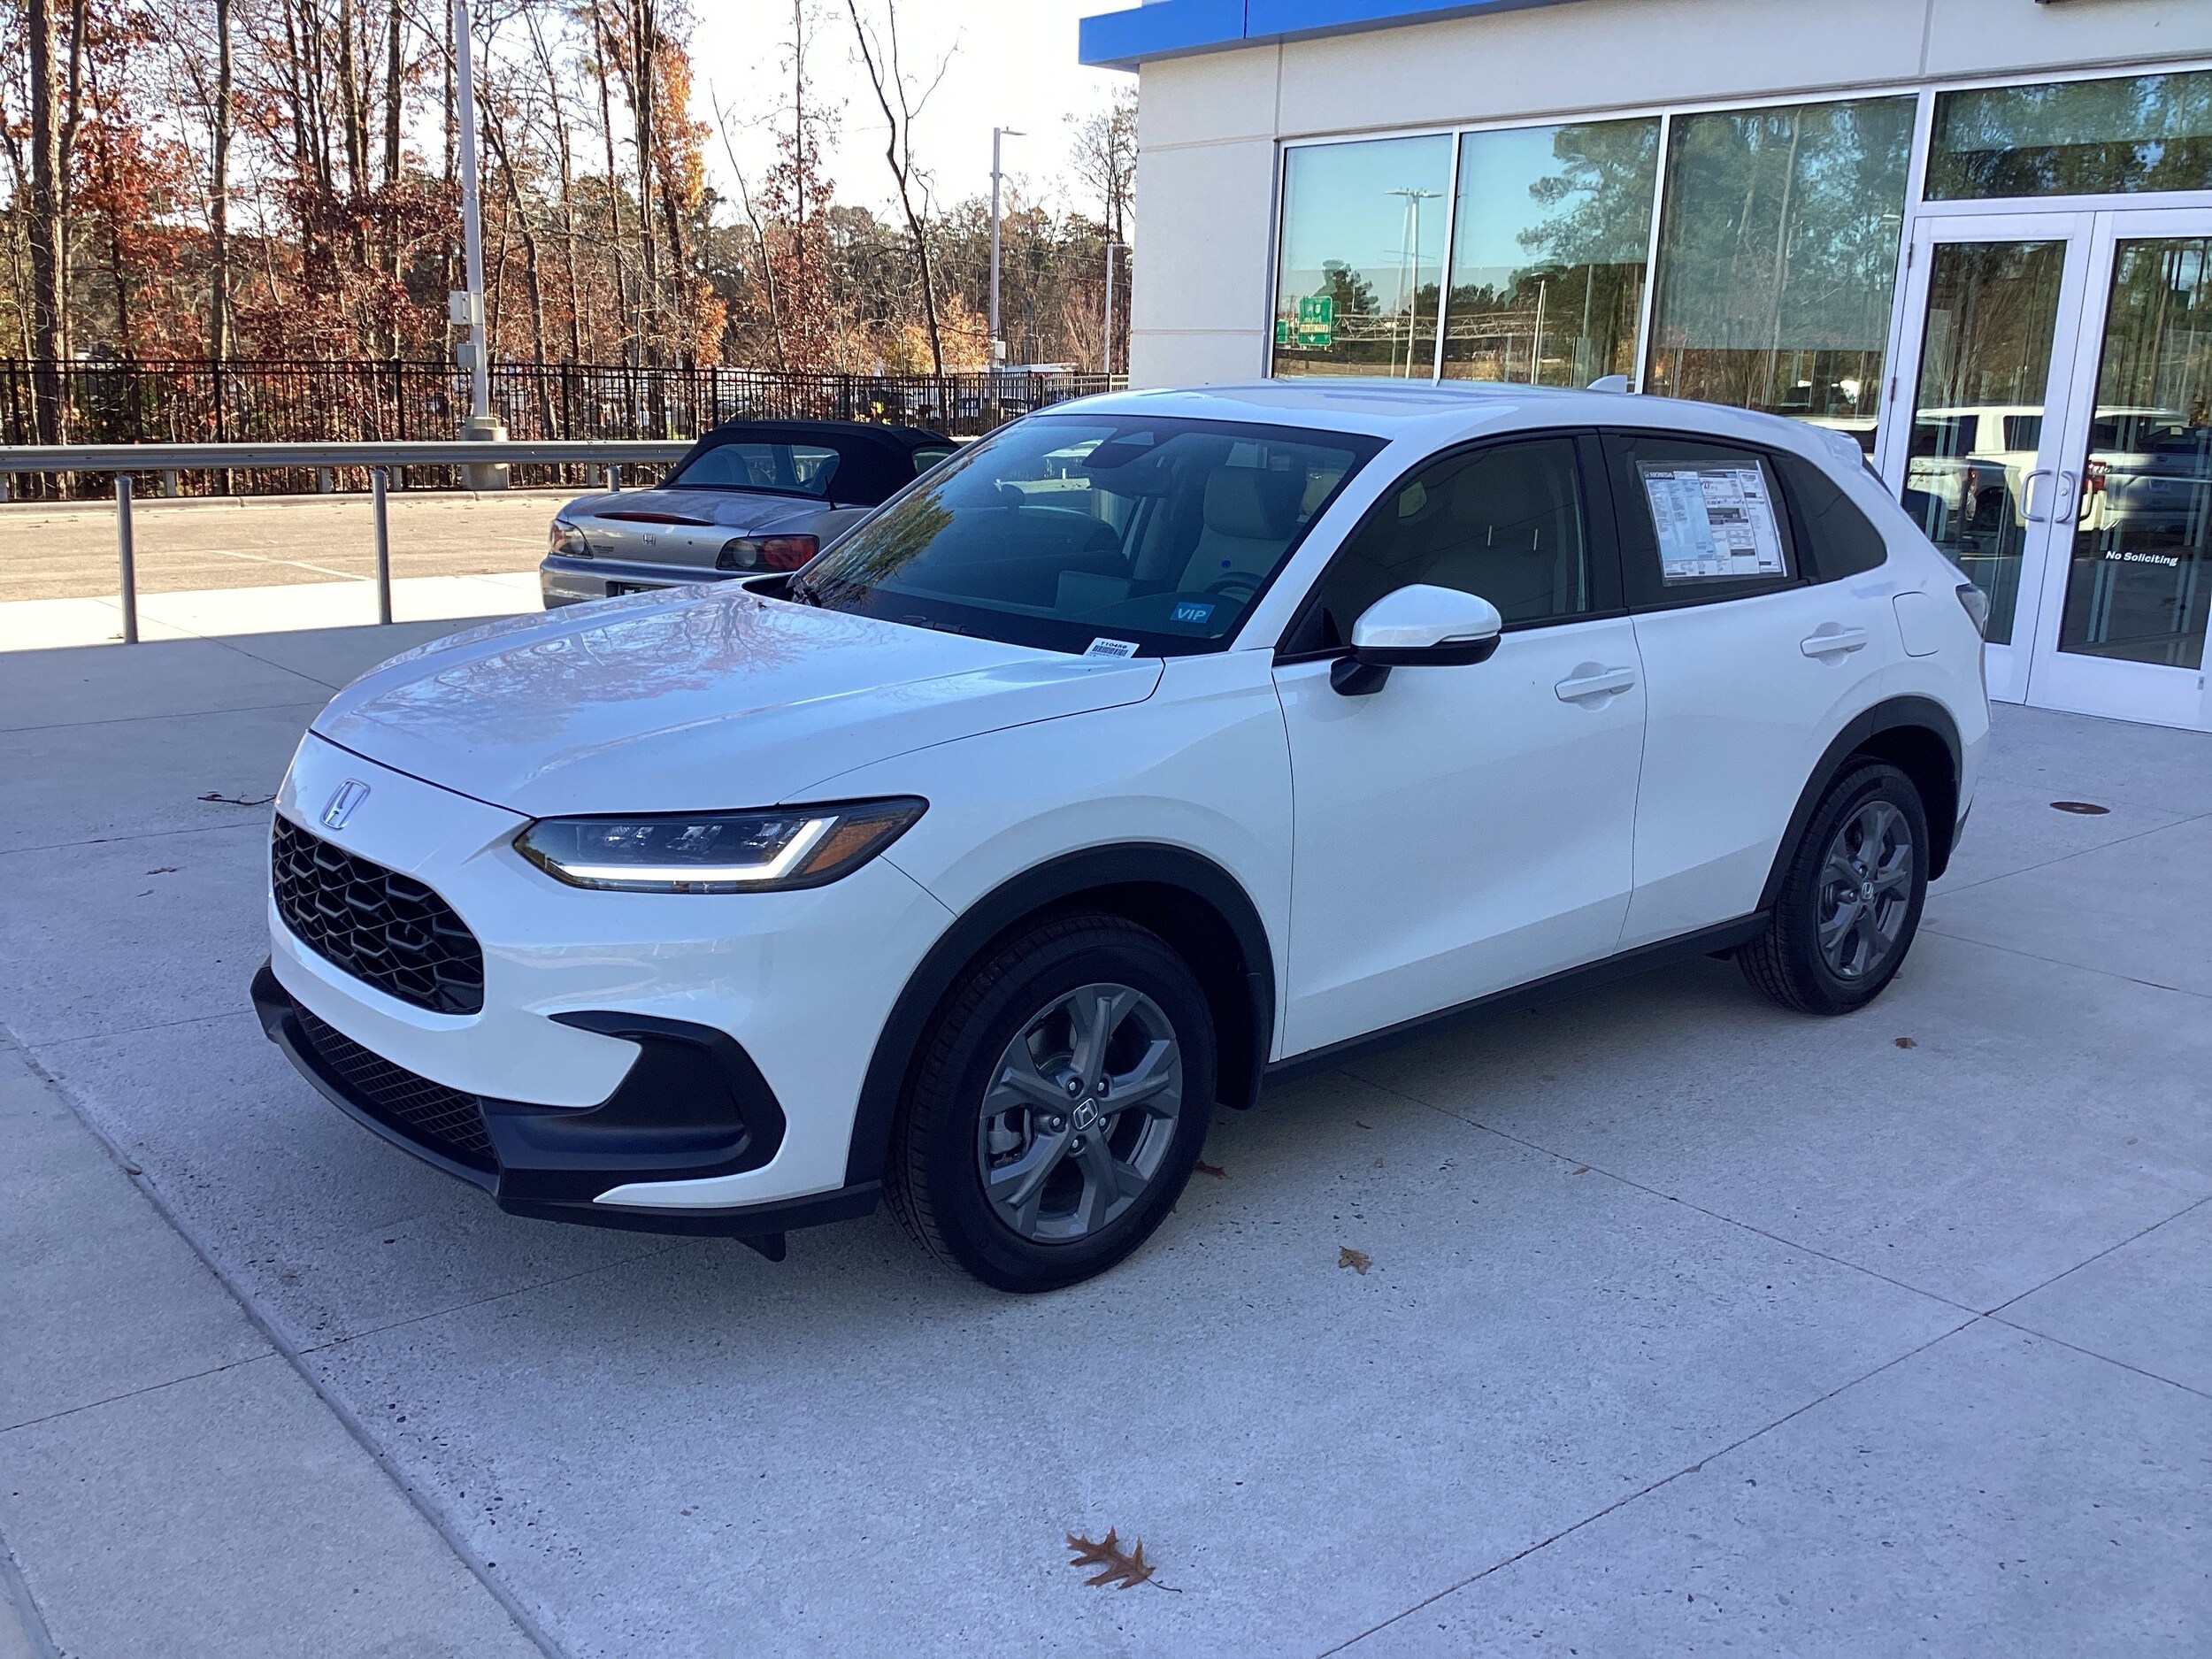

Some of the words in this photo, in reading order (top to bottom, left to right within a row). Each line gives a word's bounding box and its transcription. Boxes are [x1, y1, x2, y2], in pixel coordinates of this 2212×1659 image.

[2105, 550, 2122, 560] No
[2124, 552, 2178, 566] Soliciting
[1178, 608, 1207, 621] VIP
